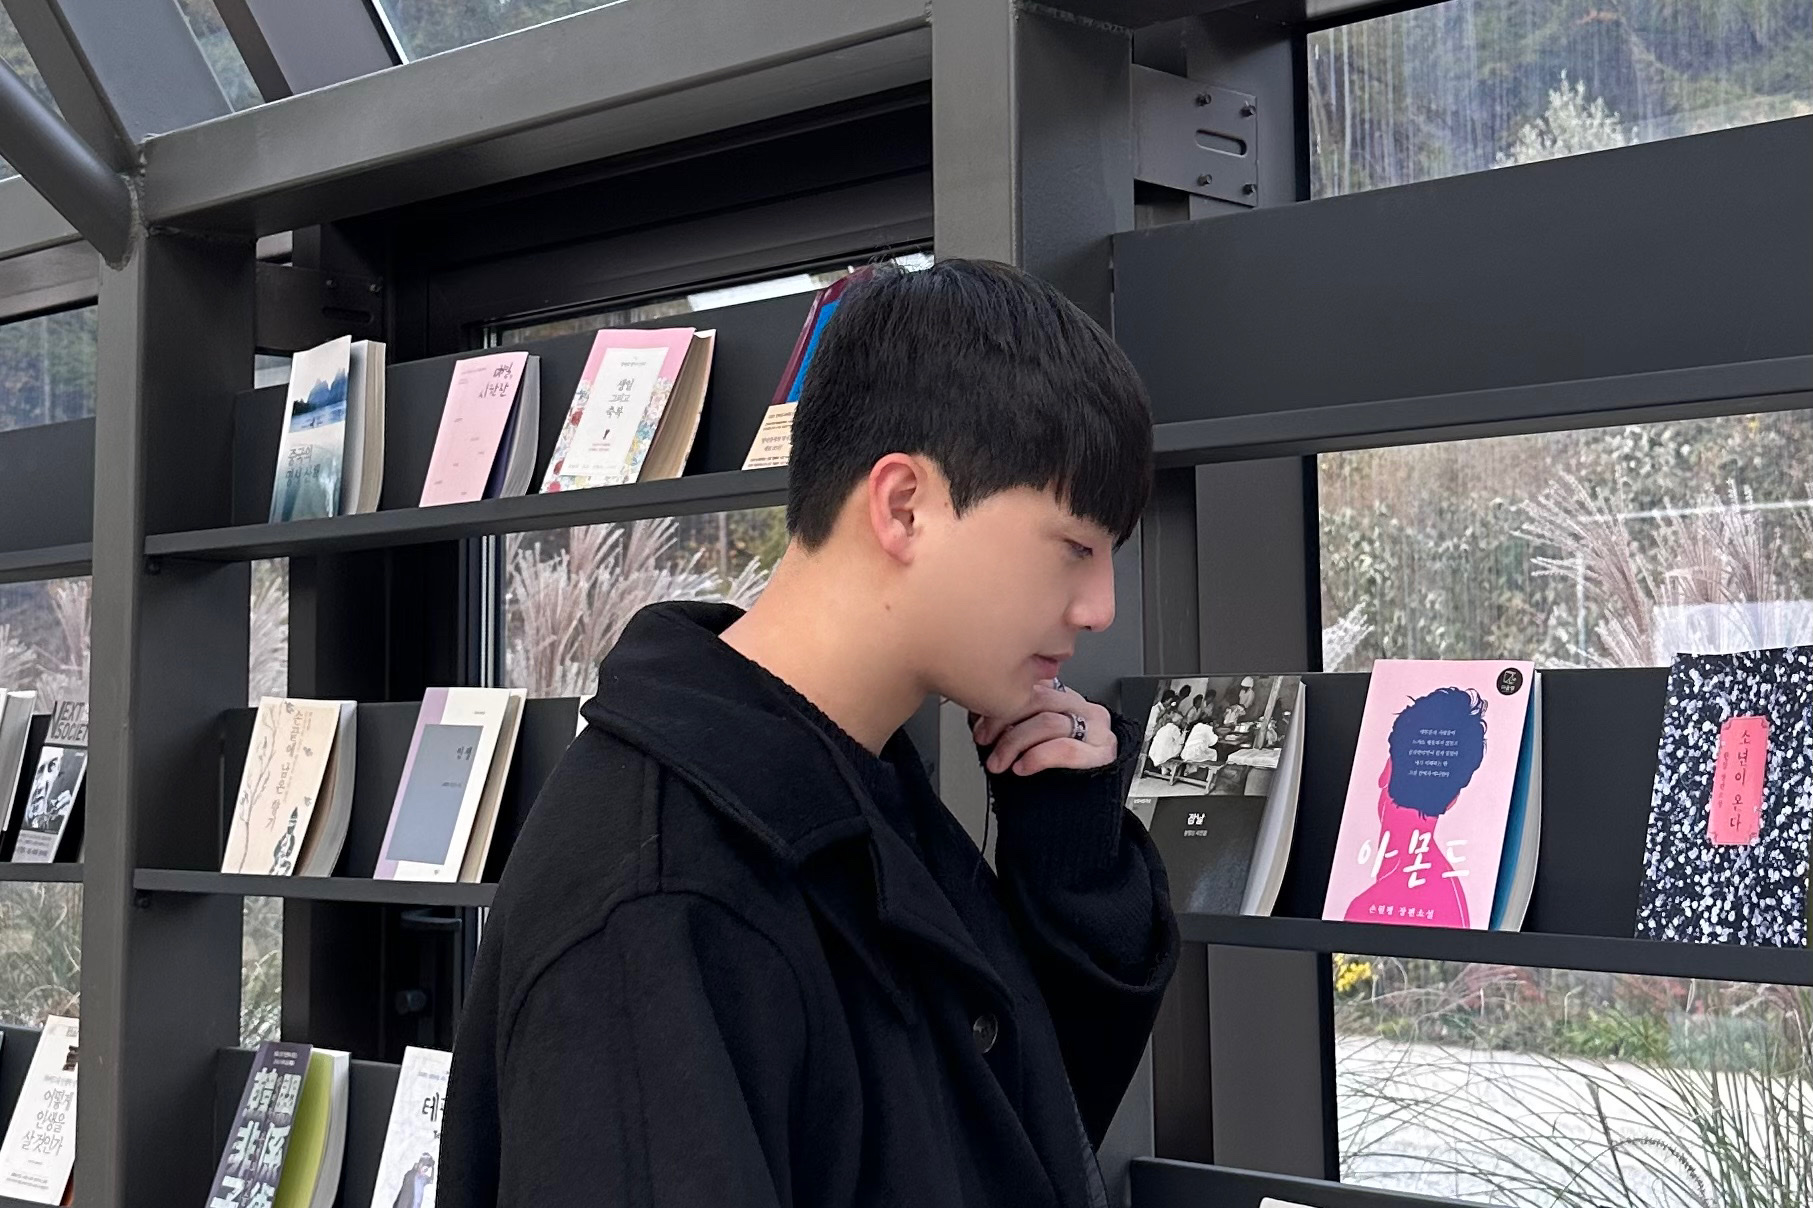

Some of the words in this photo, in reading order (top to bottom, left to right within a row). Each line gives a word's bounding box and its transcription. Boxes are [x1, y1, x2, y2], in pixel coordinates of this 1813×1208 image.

[1735, 730, 1750, 786] 소년이
[1730, 794, 1743, 832] 온다
[1357, 829, 1470, 888] 아몬드
[1398, 907, 1435, 920] 장편소설
[44, 1088, 74, 1111] 어떻게
[422, 1092, 447, 1122] 테
[36, 1110, 65, 1133] 인생을
[22, 1130, 35, 1150] 살
[33, 1132, 63, 1156] 것인가
